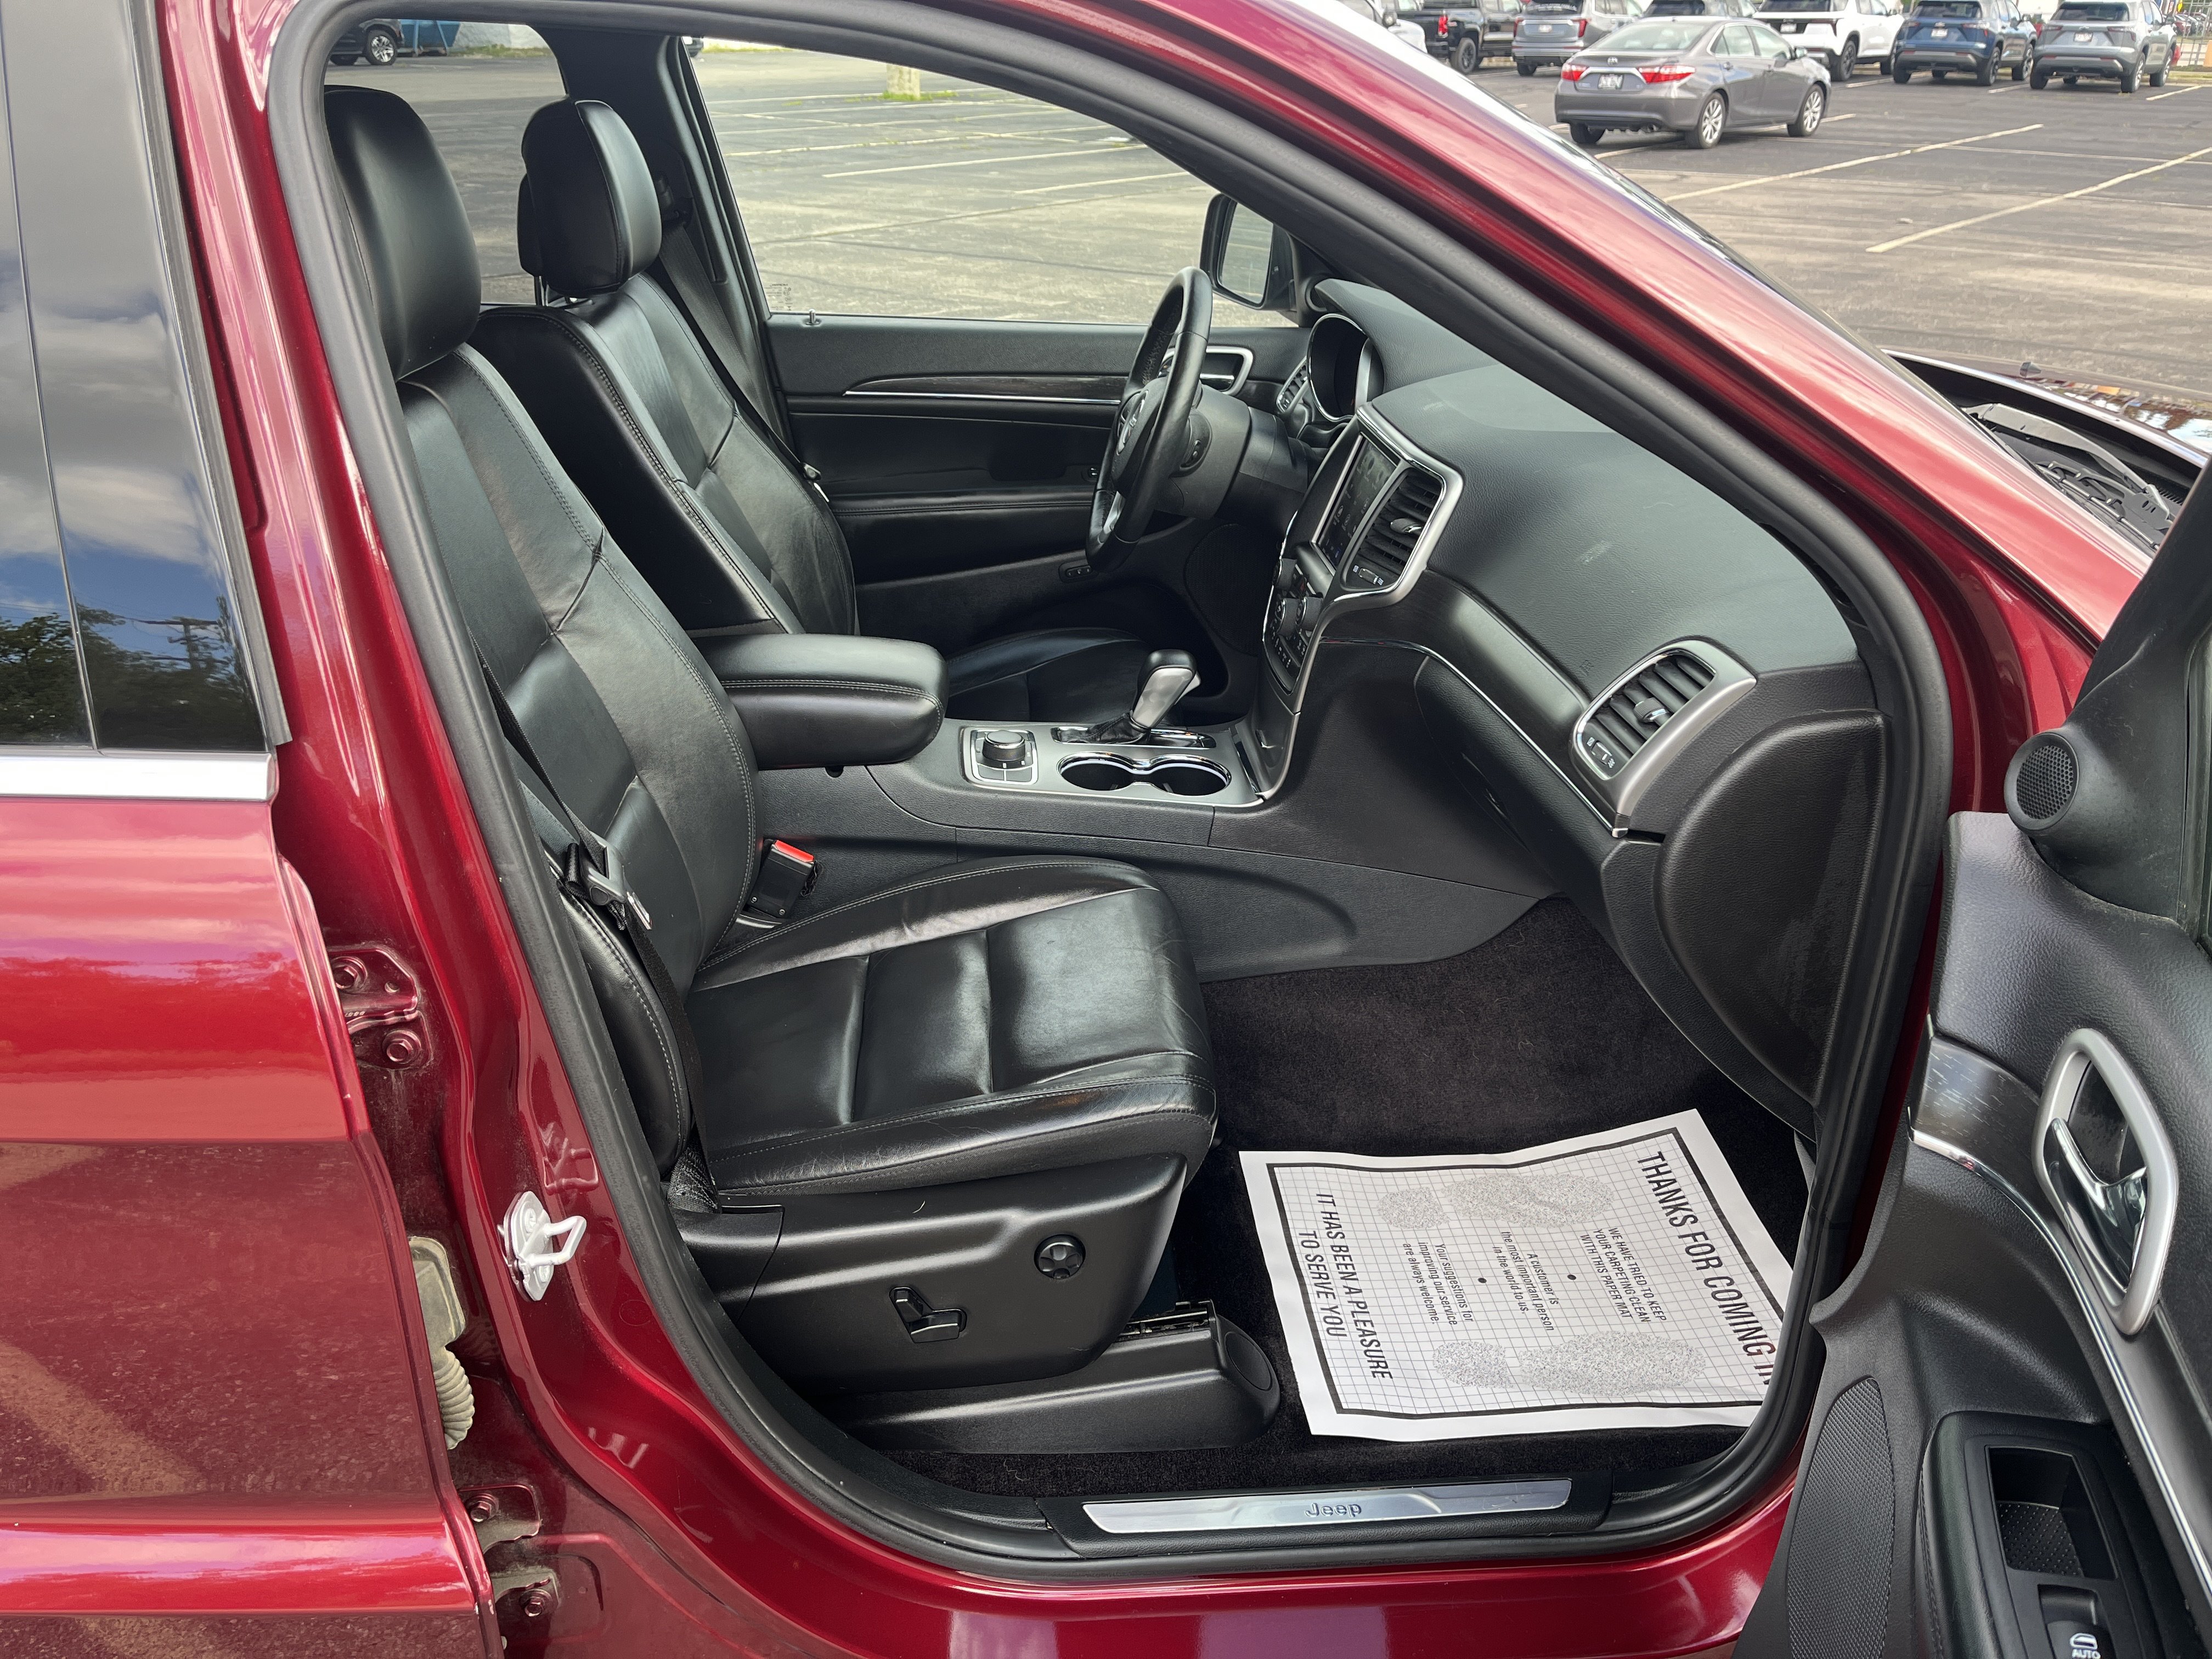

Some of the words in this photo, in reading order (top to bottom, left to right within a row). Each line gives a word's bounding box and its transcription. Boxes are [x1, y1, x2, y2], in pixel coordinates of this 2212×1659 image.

[1316, 1194, 1336, 1207] IT
[1321, 1210, 1345, 1239] HAS
[1609, 1227, 1623, 1240] WE
[1299, 1230, 1320, 1249] TO
[1330, 1245, 1358, 1281] BEEN
[1498, 1255, 1508, 1267] the
[1616, 1242, 1634, 1261] HAVE
[1637, 1152, 1698, 1227] THANKS
[1678, 1232, 1723, 1270] FOR
[1703, 1276, 1776, 1356] COMING
[1305, 1254, 1336, 1300] SERVE
[1403, 1244, 1413, 1255] are
[1408, 1257, 1425, 1284] always
[1420, 1285, 1439, 1324] welcome.
[1418, 1242, 1438, 1279] improving
[1434, 1282, 1445, 1294] our
[1440, 1295, 1457, 1325] service
[1435, 1244, 1449, 1260] Your
[1443, 1262, 1467, 1308] suggestions
[1462, 1310, 1474, 1322] for
[1501, 1231, 1512, 1243] the
[1508, 1245, 1522, 1262] most
[1517, 1264, 1542, 1302] important
[1532, 1304, 1554, 1330] person
[1503, 1269, 1519, 1290] world
[1531, 1260, 1554, 1295] customer
[1580, 1234, 1597, 1254] WITH
[1592, 1256, 1608, 1273] THIS
[1601, 1275, 1622, 1300] PAPER
[1615, 1302, 1633, 1318] MAT
[1593, 1228, 1611, 1250] YOUR
[1605, 1252, 1635, 1295] CARPETING
[1629, 1297, 1651, 1322] CLEAN
[1627, 1262, 1647, 1285] TRIED
[1343, 1285, 1363, 1295] A
[1514, 1292, 1523, 1302] to
[1641, 1288, 1654, 1298] TO
[1517, 1303, 1528, 1314] us.
[1647, 1300, 1667, 1321] KEEP
[1320, 1305, 1347, 1337] YOU
[1347, 1300, 1393, 1379] PLEASURE
[1305, 1503, 1362, 1517] Jeep
[2072, 1649, 2101, 1659] AUTO
